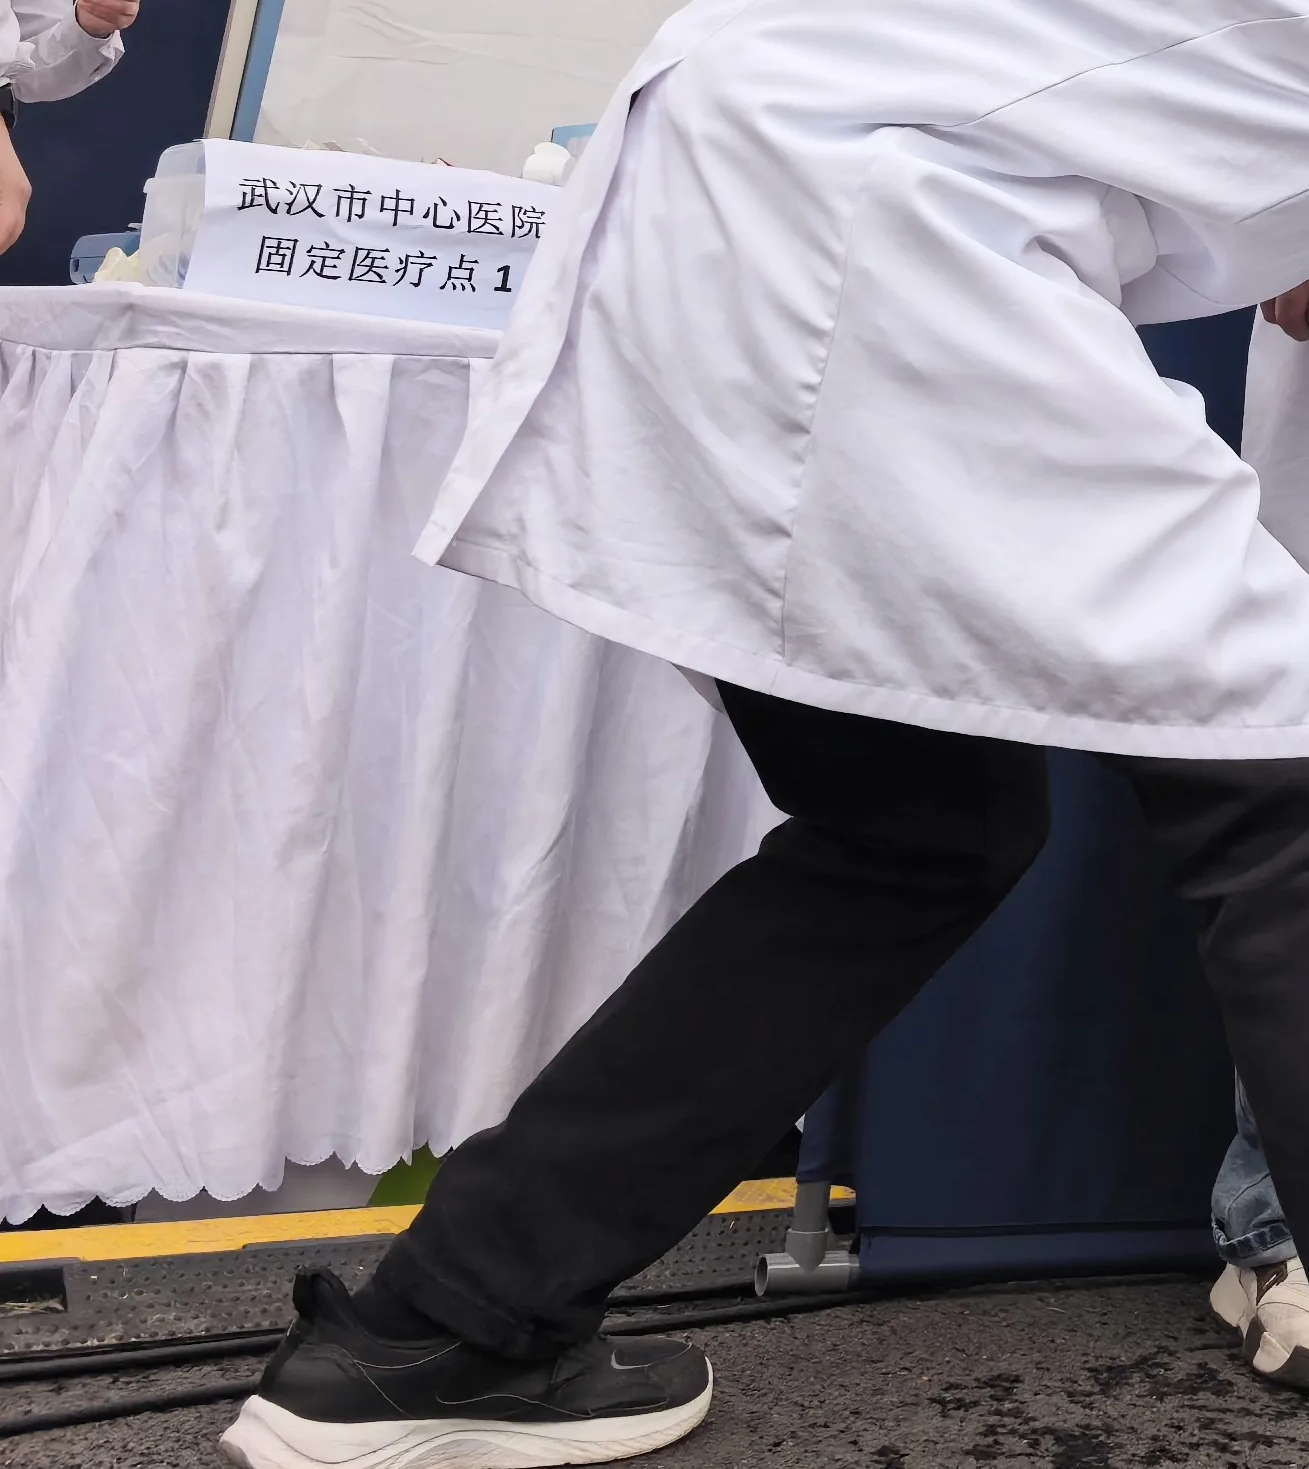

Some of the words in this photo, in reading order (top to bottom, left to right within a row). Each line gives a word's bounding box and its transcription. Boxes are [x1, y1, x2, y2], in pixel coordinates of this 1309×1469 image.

[236, 176, 547, 239] 武汉市中心医院
[255, 236, 478, 293] 固定医疗点
